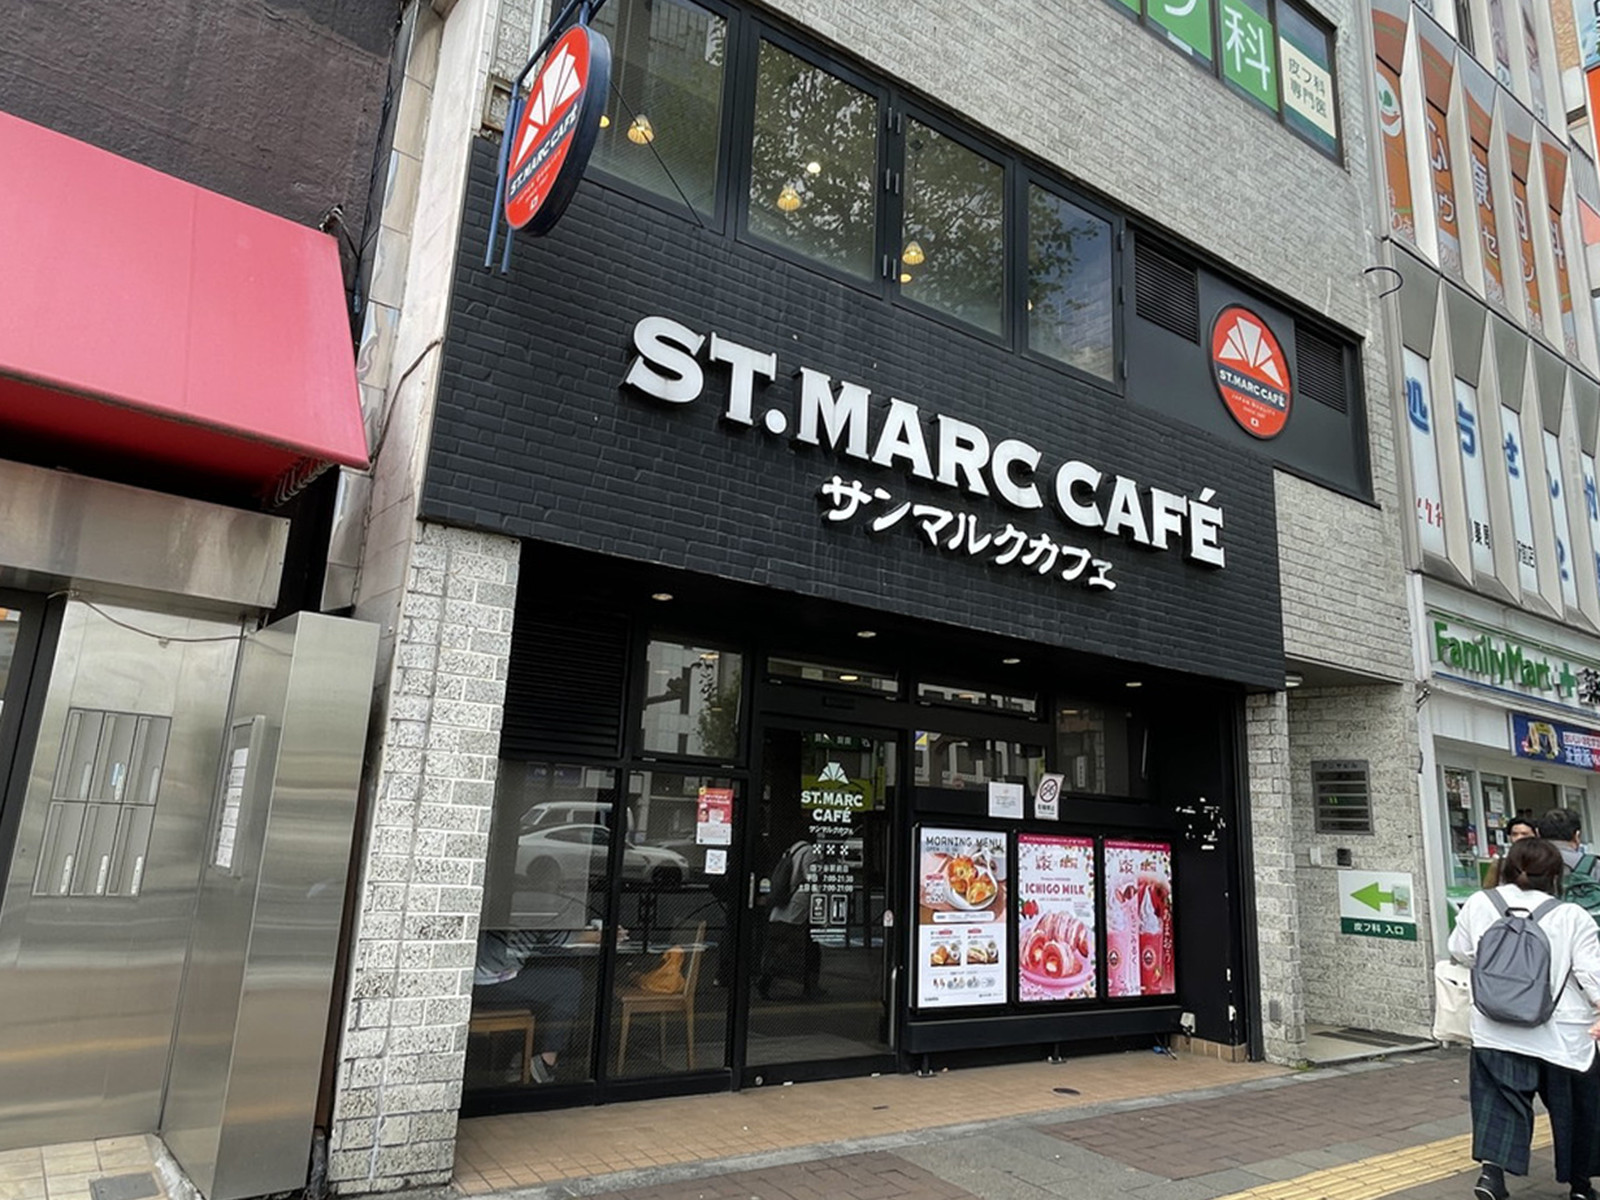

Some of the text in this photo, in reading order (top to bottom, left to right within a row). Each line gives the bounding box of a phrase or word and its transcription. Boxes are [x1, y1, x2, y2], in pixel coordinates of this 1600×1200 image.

[1219, 369, 1286, 408] ST.MARC CAFÉ
[622, 315, 1226, 569] ST.MARC CAFÉ
[821, 474, 1117, 592] サンマルクカフェ
[1433, 621, 1553, 692] FamilyMart
[801, 790, 863, 807] ST.MARC
[812, 807, 852, 823] CAFÉ
[926, 836, 972, 848] MORNING
[1025, 883, 1085, 895] ICHIGO MILK
[1385, 924, 1404, 935] 入口
